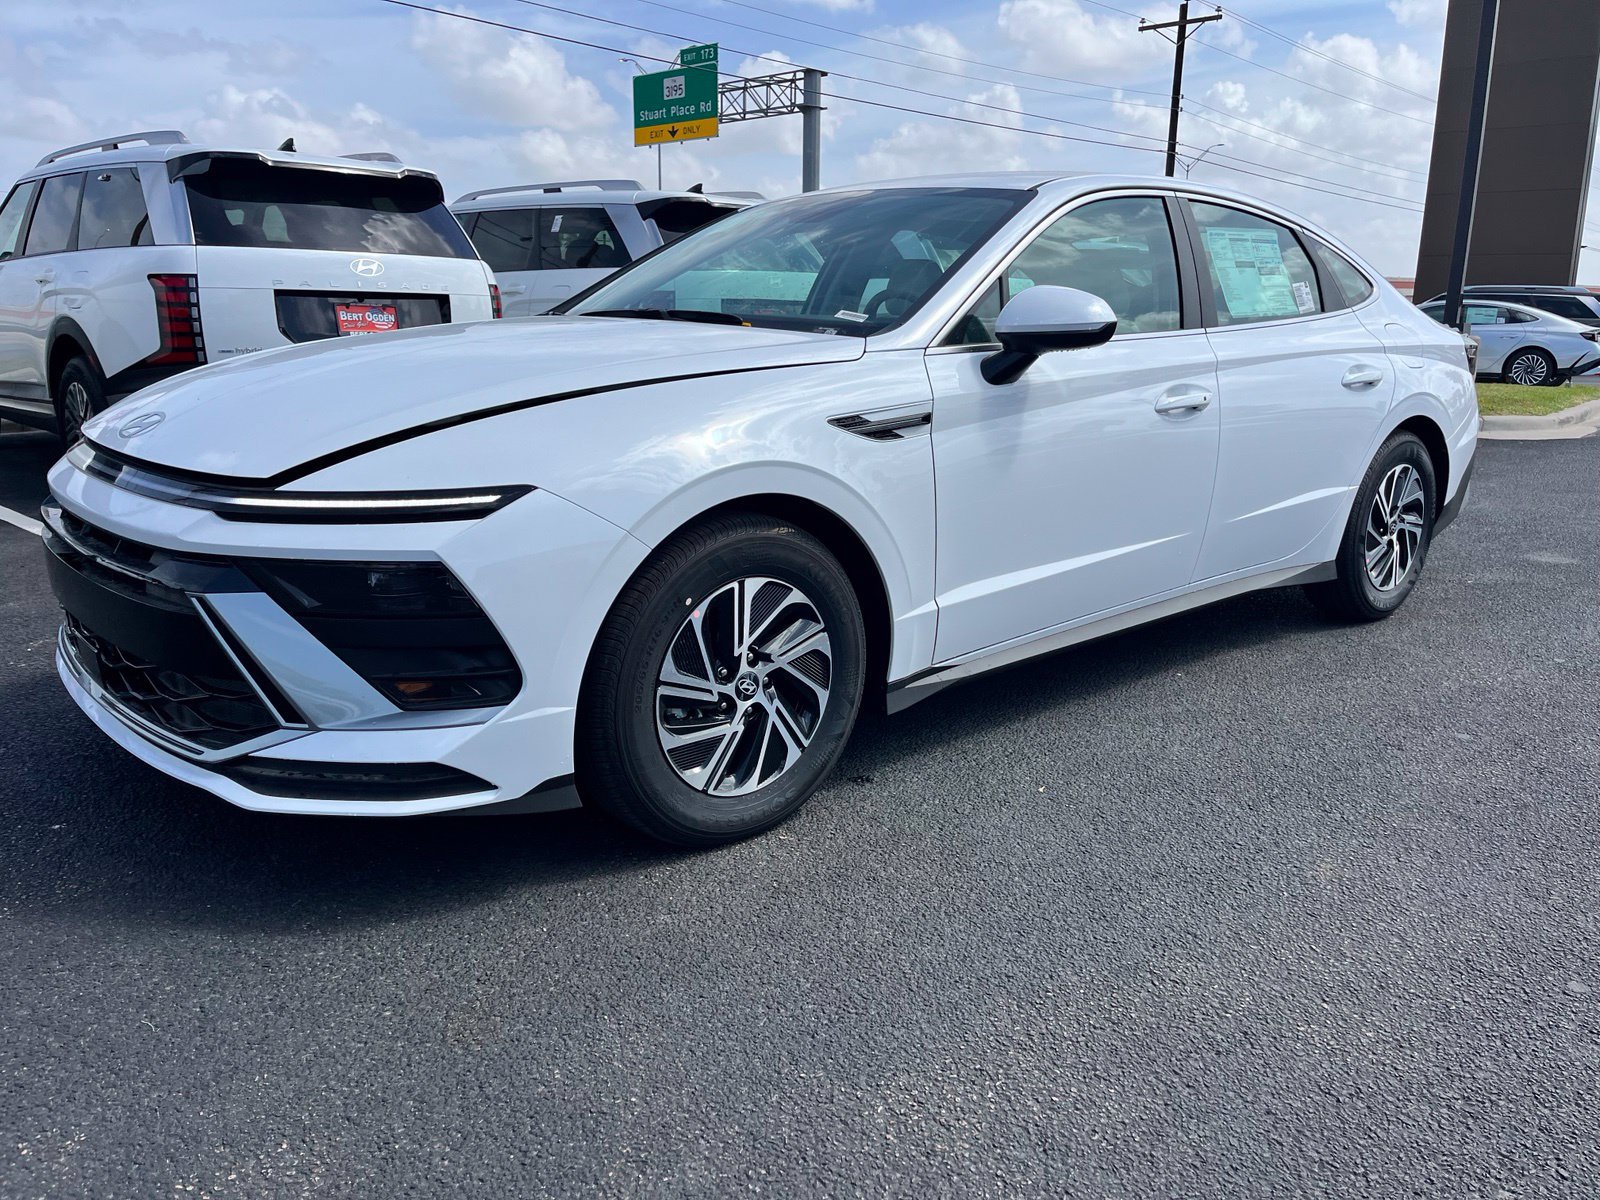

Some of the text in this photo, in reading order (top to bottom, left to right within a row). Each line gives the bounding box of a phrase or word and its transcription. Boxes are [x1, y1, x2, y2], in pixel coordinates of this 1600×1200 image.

[683, 48, 714, 61] EXIT 173
[665, 84, 684, 98] 3195
[640, 100, 712, 121] Stuart Place Rd
[650, 125, 701, 139] EXIT ONLY
[272, 279, 449, 292] PALISADE
[340, 311, 395, 322] BERT OGDEN
